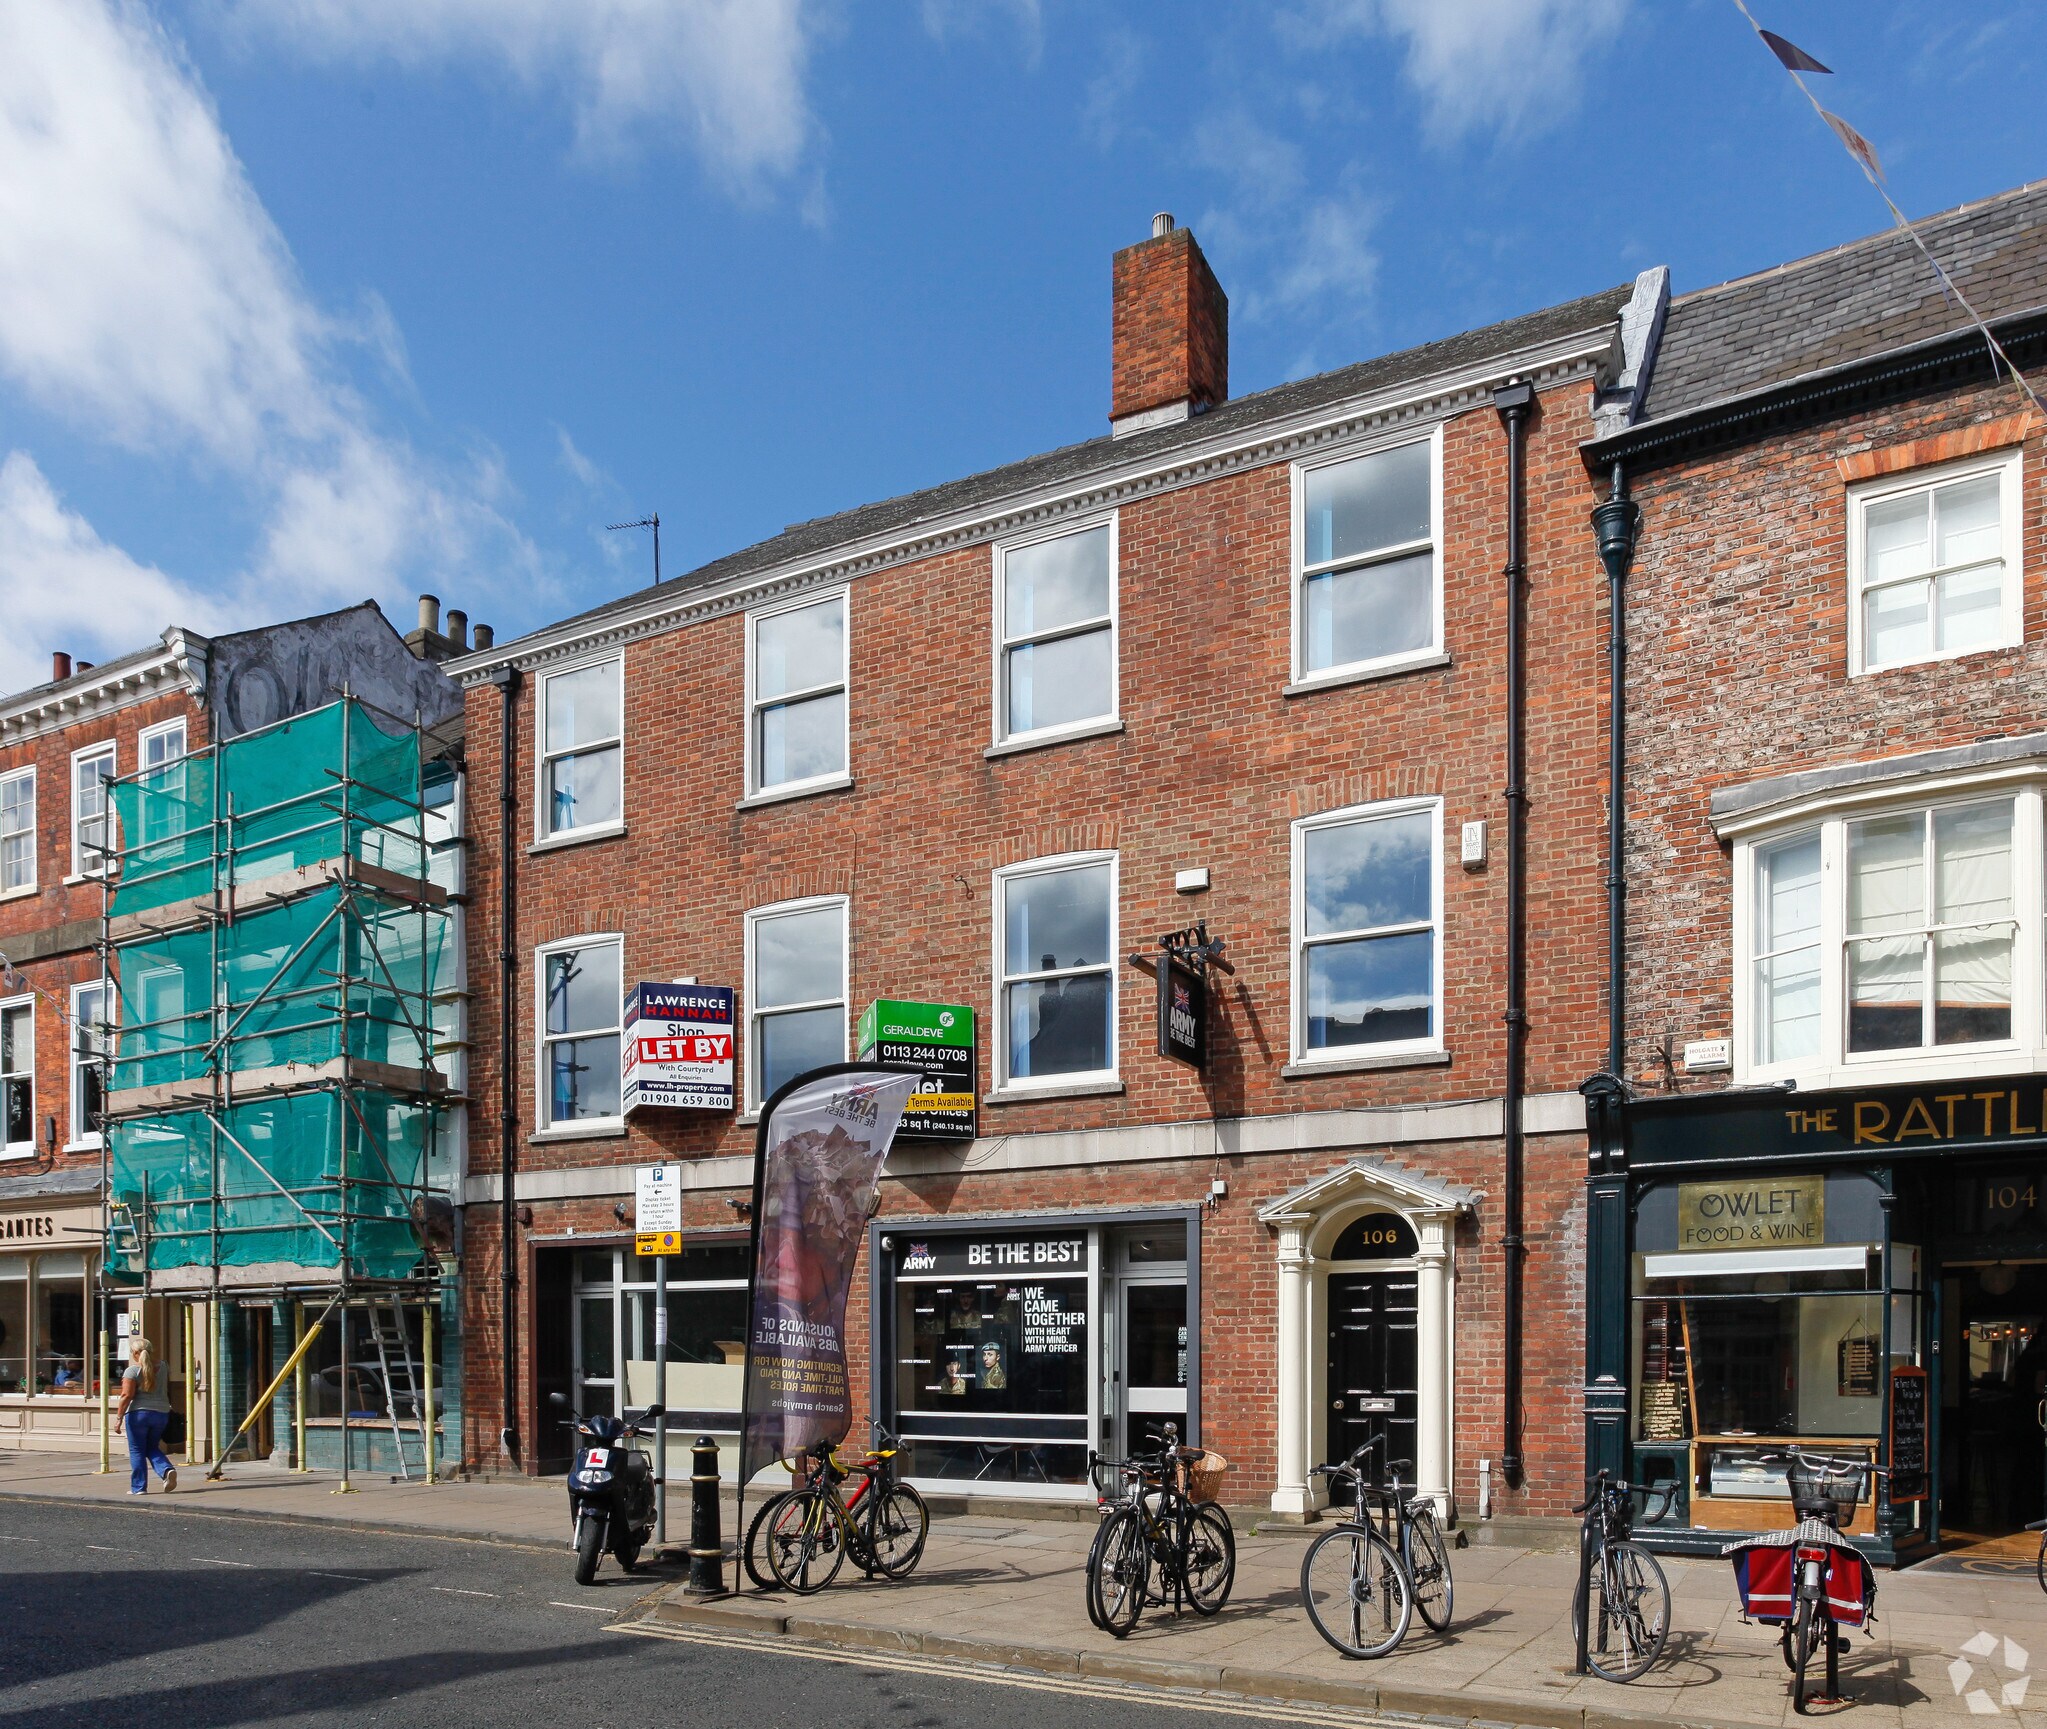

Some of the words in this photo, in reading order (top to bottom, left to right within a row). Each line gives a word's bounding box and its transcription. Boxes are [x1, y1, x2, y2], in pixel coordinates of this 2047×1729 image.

[646, 994, 726, 1009] LAWRENCE
[645, 1006, 727, 1020] HANNAH
[1170, 1006, 1196, 1038] ARMY
[667, 1023, 705, 1036] Shop
[883, 1025, 944, 1038] GERALDEVE
[641, 1039, 687, 1060] LET
[694, 1037, 727, 1058] BY
[883, 1045, 911, 1058] 0113
[913, 1047, 936, 1060] 244
[937, 1048, 967, 1061] 0708
[1689, 1046, 1719, 1055] HOLGATE
[1699, 1052, 1726, 1060] ALARMS
[677, 1065, 714, 1074] Courtyard
[646, 1082, 725, 1092] www.lh-property.com
[641, 1093, 676, 1104] 01904
[682, 1096, 703, 1105] 659
[708, 1097, 729, 1106] 800
[911, 1098, 935, 1108] Terms
[937, 1097, 972, 1107] Available
[1785, 1108, 1838, 1133] THE
[1854, 1088, 2047, 1145] RATTL
[909, 1120, 921, 1130] sq
[923, 1119, 930, 1129] ft
[655, 1169, 662, 1181] P
[1988, 1184, 2038, 1208] 104
[1700, 1189, 1802, 1218] OWLET
[1362, 1229, 1397, 1245] 106
[1686, 1226, 1744, 1243] FOOD
[1750, 1225, 1762, 1240] &
[1768, 1222, 1815, 1240] WINE
[968, 1244, 992, 1265] BE
[994, 1243, 1030, 1264] THE
[1033, 1240, 1083, 1263] BEST
[902, 1256, 937, 1270] ARMY
[1024, 1287, 1045, 1300] WE
[1024, 1300, 1059, 1313] CAME
[1024, 1313, 1085, 1326] TOGETHER
[1024, 1327, 1045, 1336] WITH
[1046, 1327, 1071, 1335] HEART
[1024, 1336, 1045, 1344] WITH
[1046, 1335, 1069, 1344] MIND.
[1024, 1344, 1047, 1353] ARMY
[1048, 1344, 1078, 1353] OFFICER
[590, 1452, 603, 1464] L
